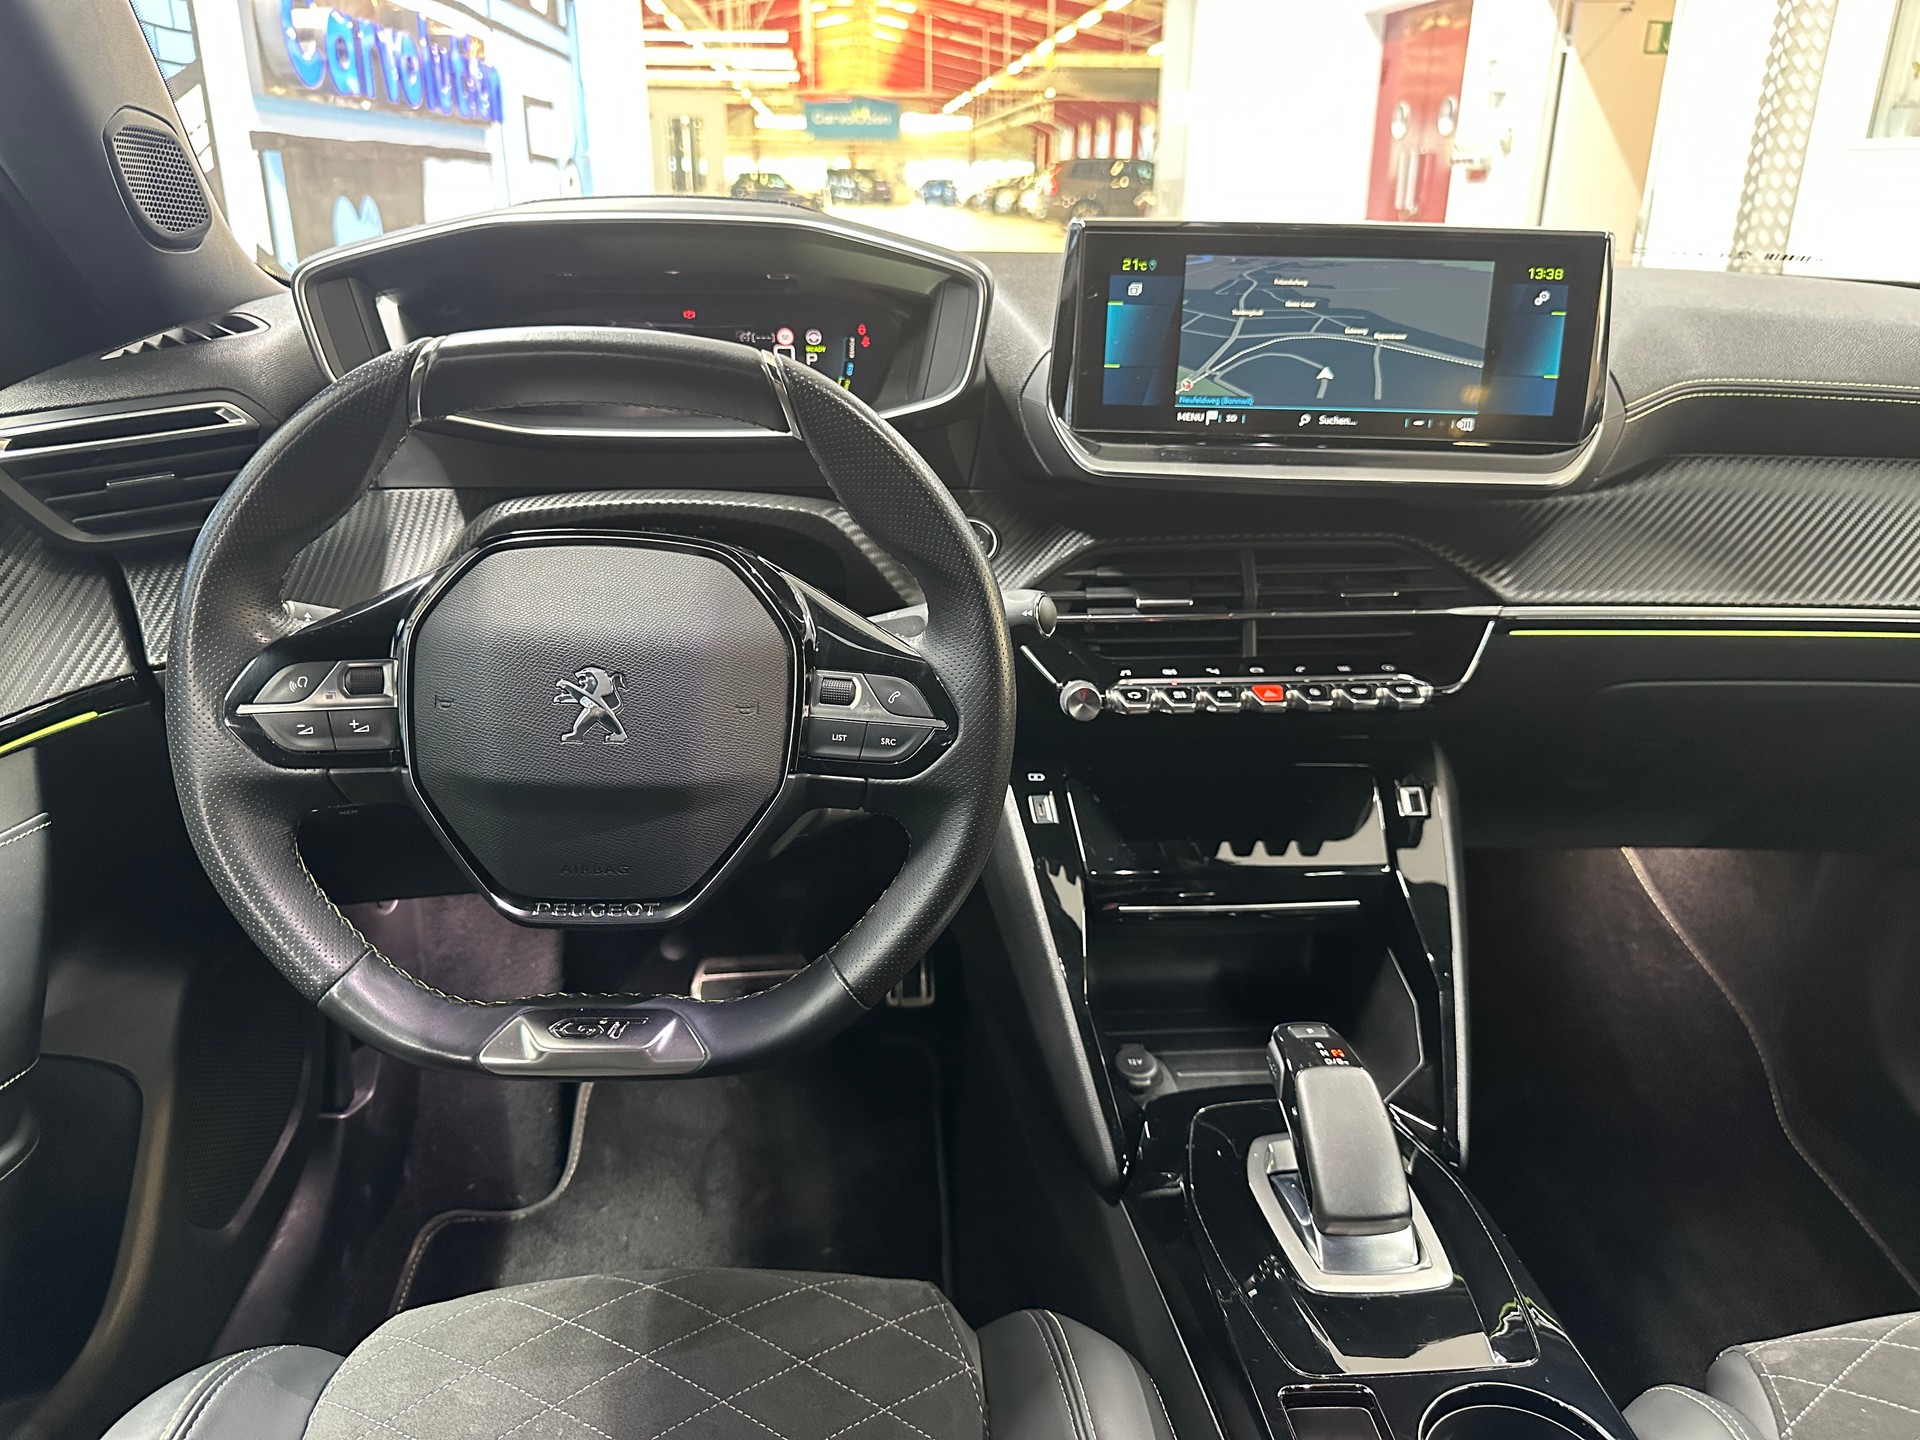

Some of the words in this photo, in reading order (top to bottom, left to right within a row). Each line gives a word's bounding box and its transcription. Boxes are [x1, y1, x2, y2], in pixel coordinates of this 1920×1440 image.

[1528, 267, 1564, 280] 13:38
[806, 353, 818, 365] P
[1177, 412, 1205, 422] MENU
[881, 738, 896, 746] SRC
[560, 865, 630, 876] AIRBAG
[531, 902, 660, 918] PEUGEOT
